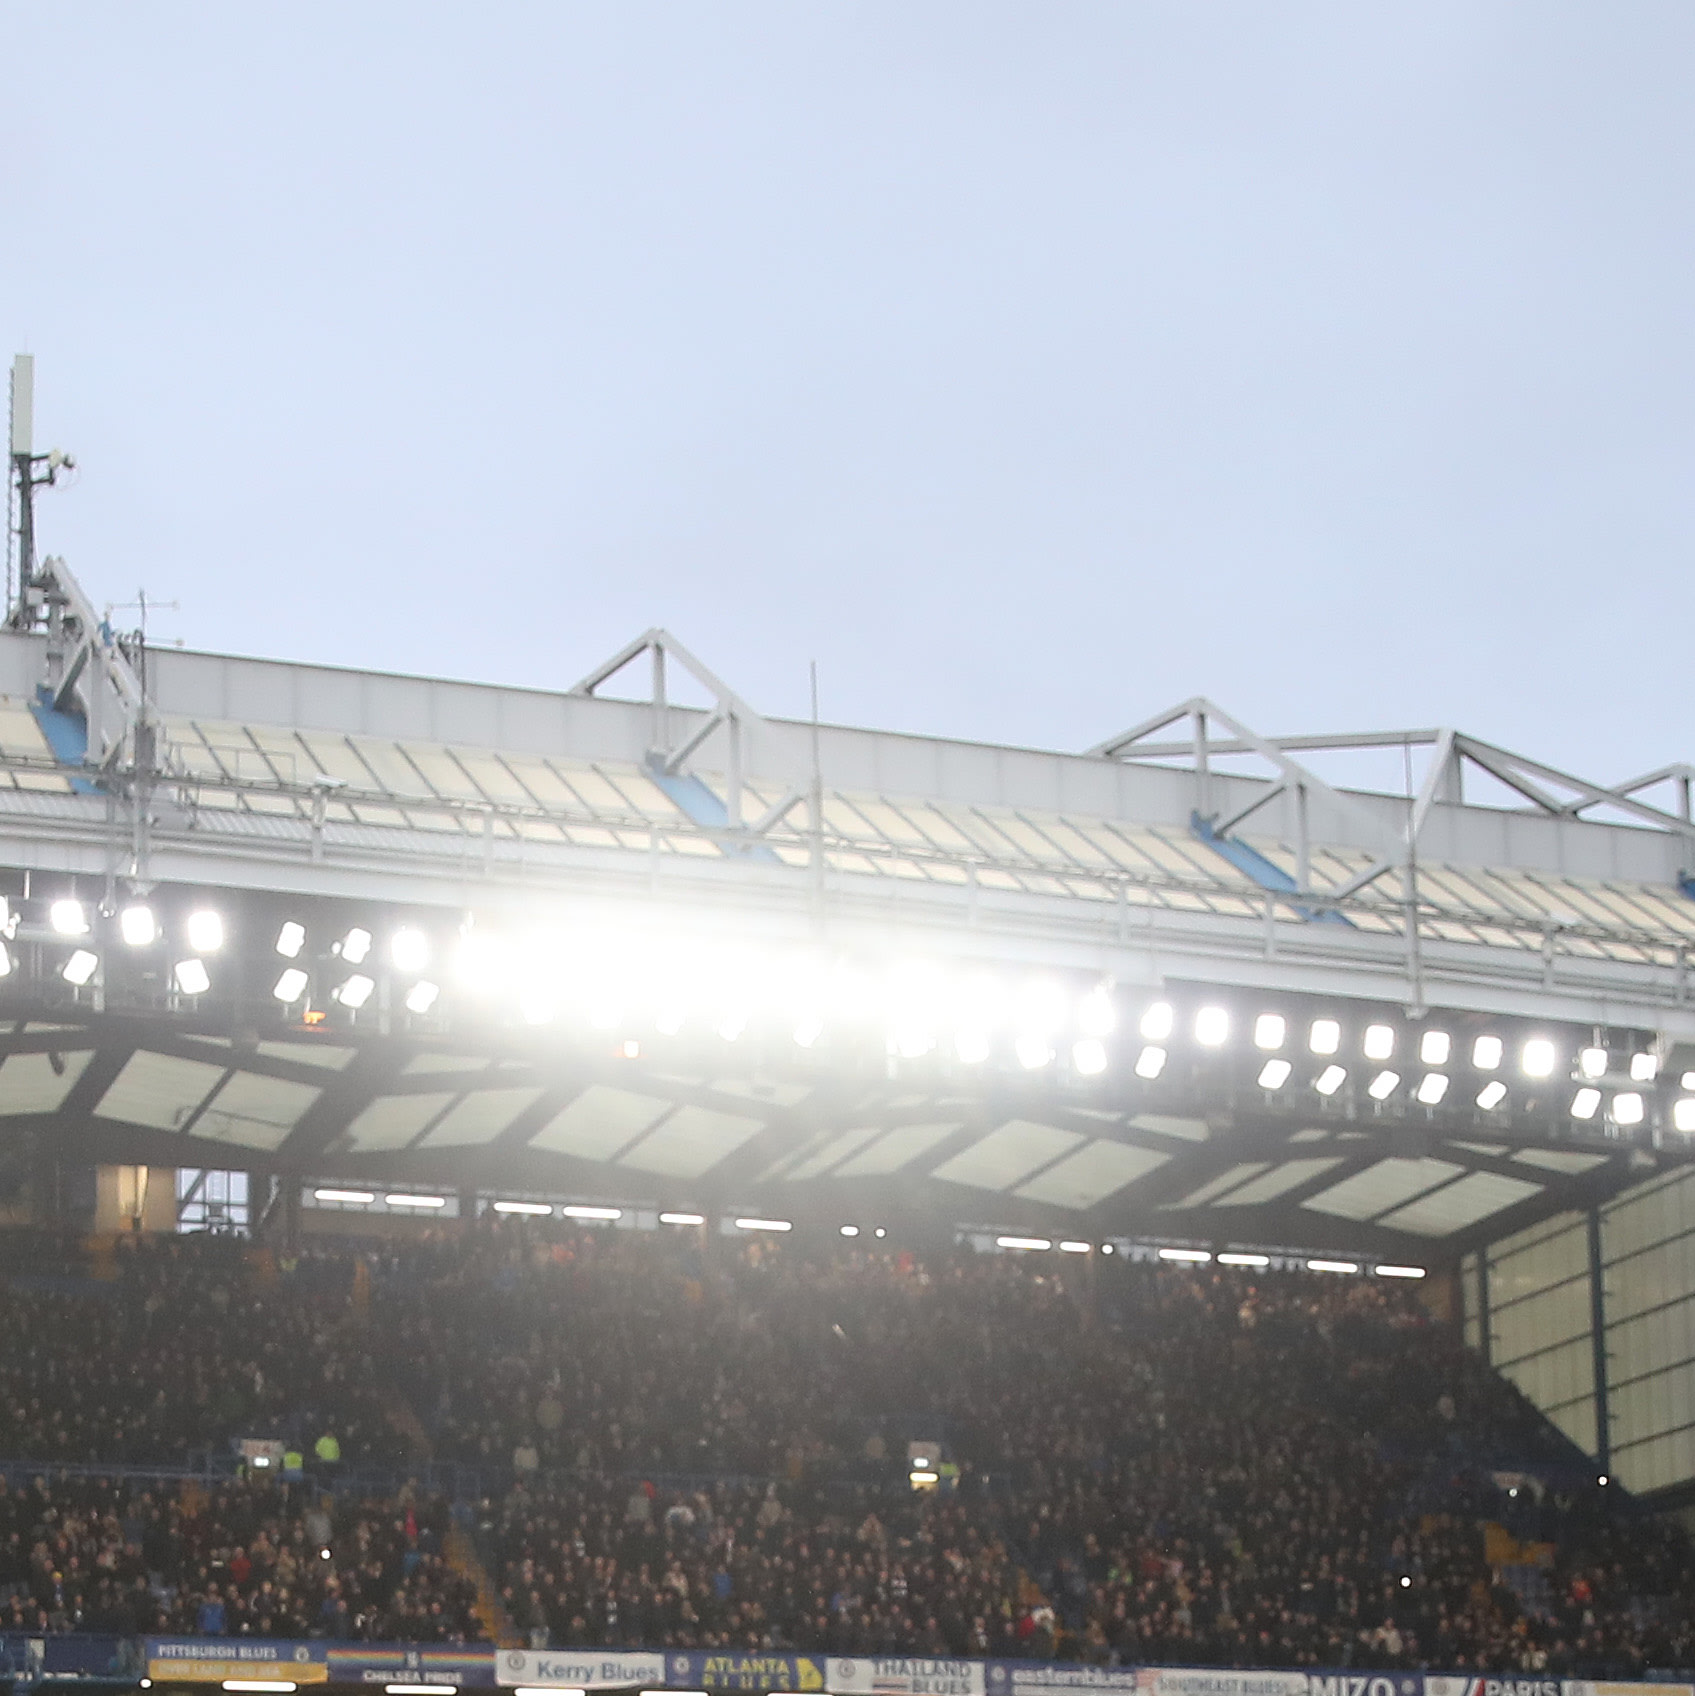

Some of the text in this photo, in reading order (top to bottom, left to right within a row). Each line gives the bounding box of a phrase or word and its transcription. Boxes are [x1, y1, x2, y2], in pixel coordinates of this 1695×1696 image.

[159, 1645, 278, 1660] PITTSBURGH BLUES
[537, 1661, 664, 1681] Kerry Blues
[706, 1656, 791, 1674] ATLANTA
[874, 1658, 972, 1678] THAILAND
[363, 1670, 421, 1683] CHELSEA
[911, 1677, 972, 1696] BLUES
